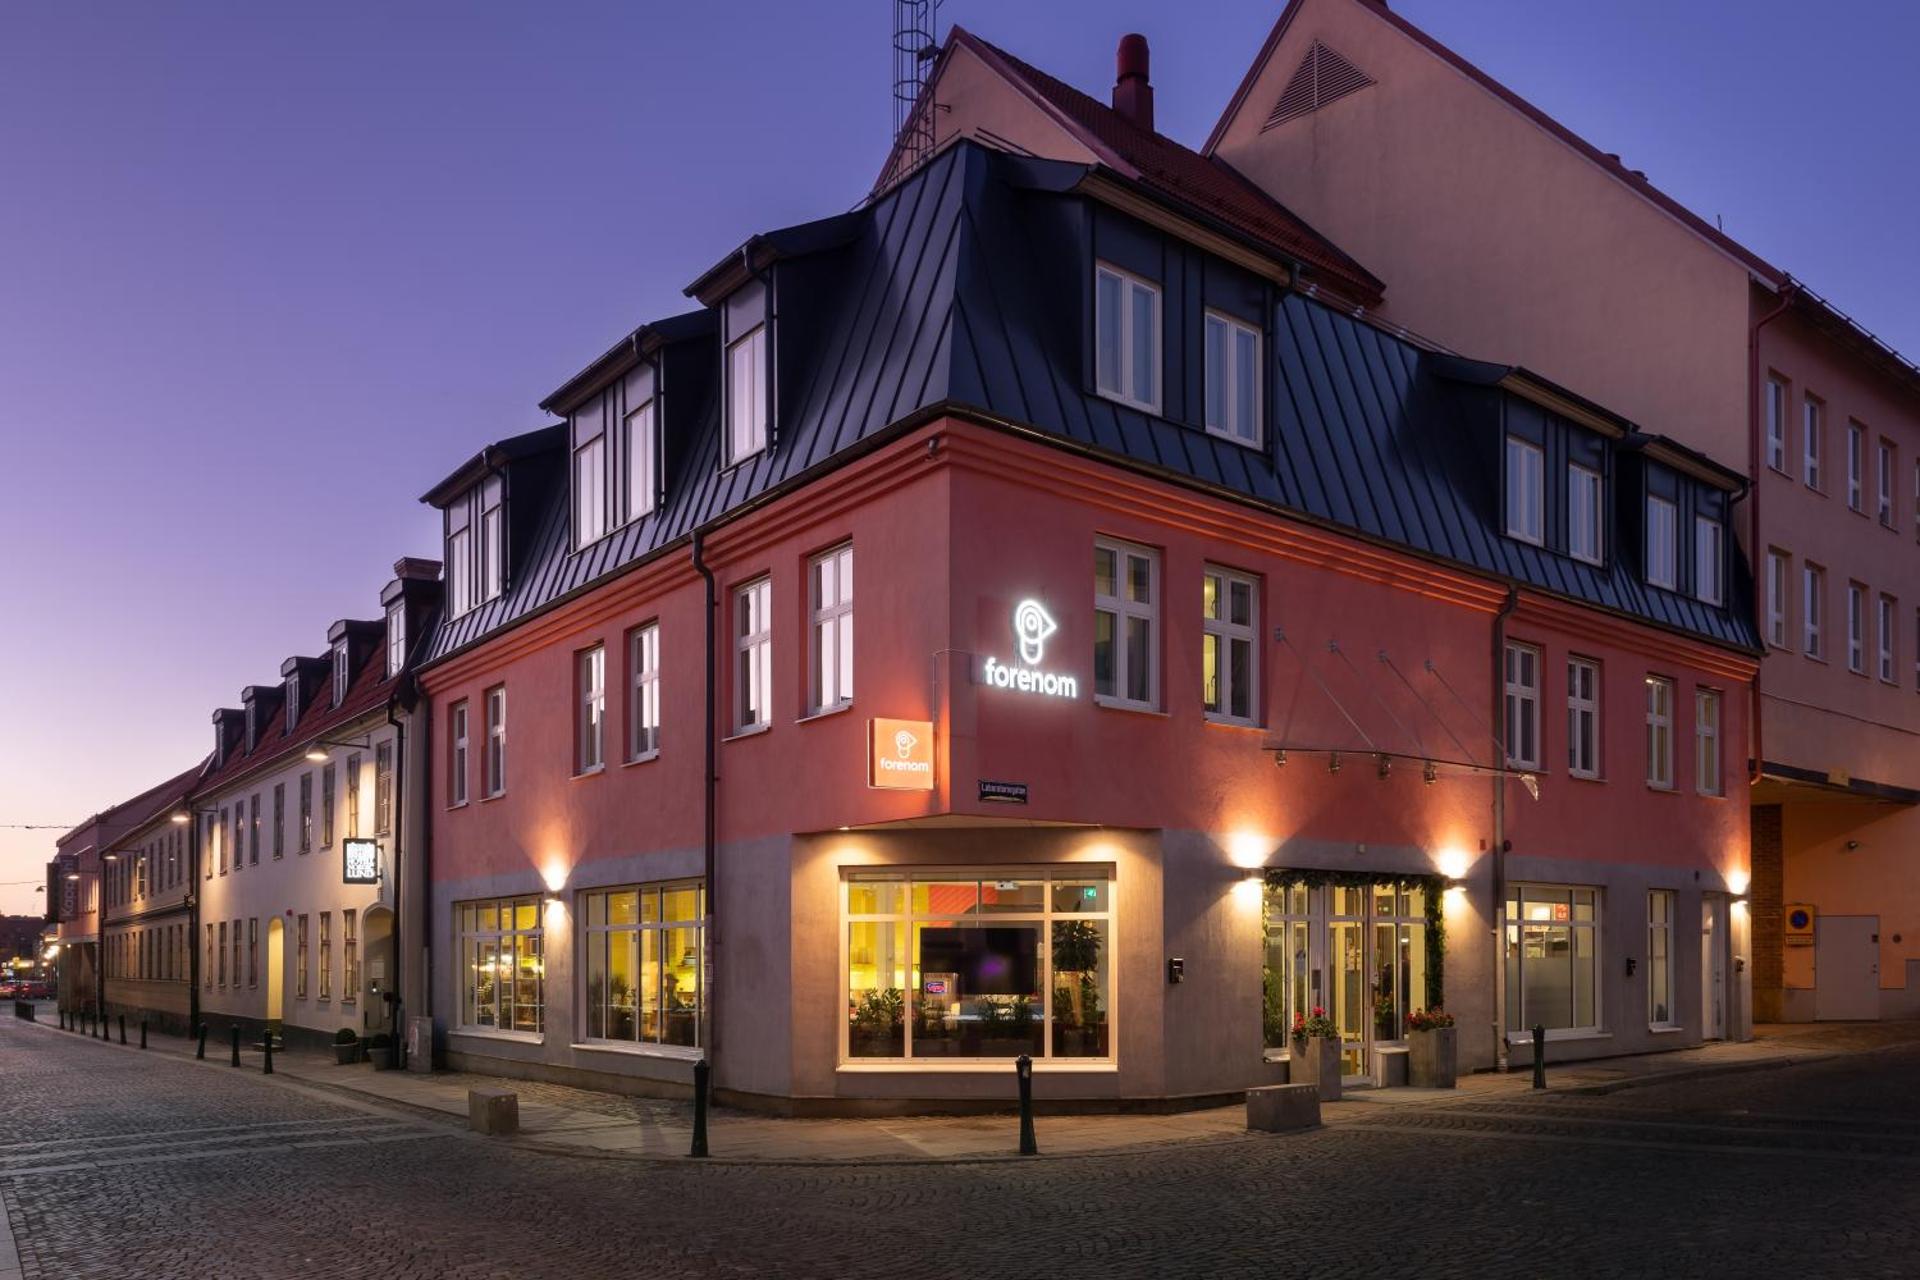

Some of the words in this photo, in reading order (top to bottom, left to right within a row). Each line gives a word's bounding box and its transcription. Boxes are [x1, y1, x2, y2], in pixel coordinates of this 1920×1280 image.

[985, 657, 1077, 698] forenom
[880, 757, 929, 772] forenom
[60, 859, 75, 917] Kapphl
